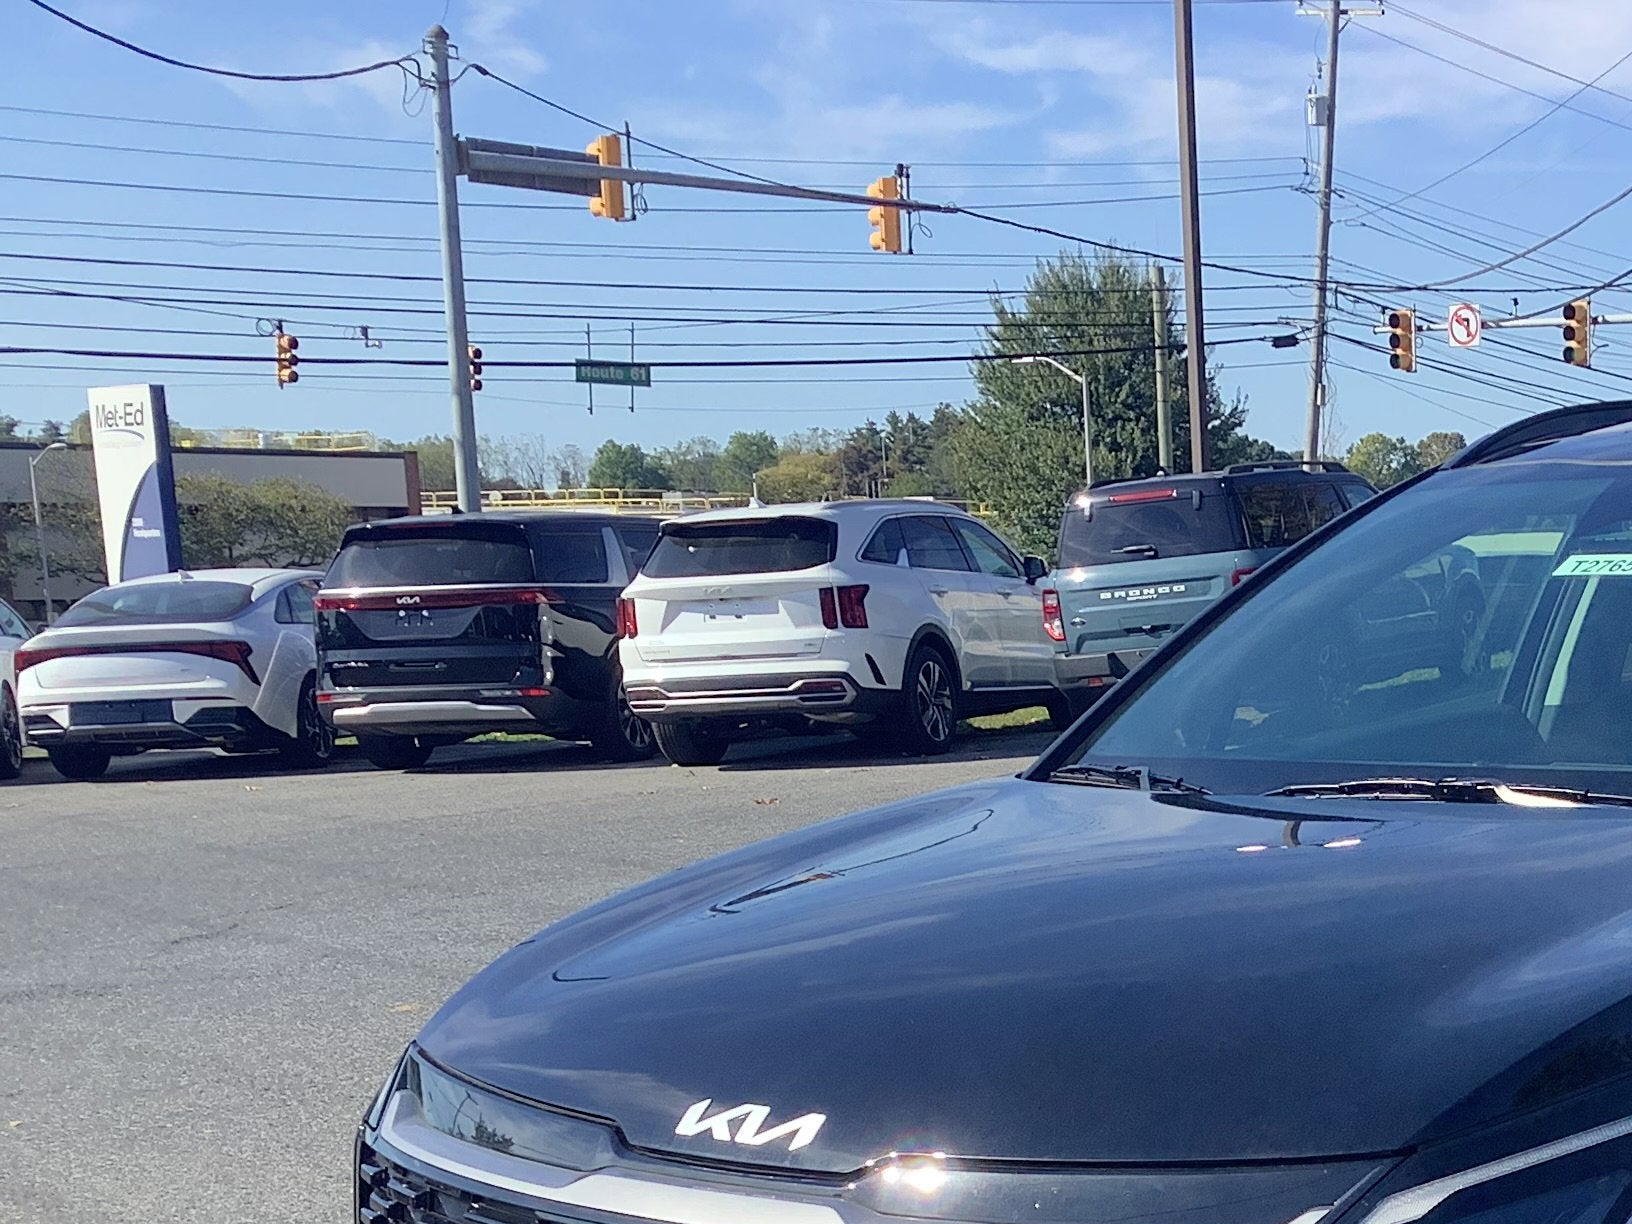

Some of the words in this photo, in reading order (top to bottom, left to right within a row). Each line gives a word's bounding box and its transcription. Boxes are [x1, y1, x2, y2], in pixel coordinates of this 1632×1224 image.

[581, 366, 624, 380] Route
[630, 367, 646, 381] 61
[96, 402, 145, 429] Met-Ed
[396, 596, 420, 604] KIA
[1100, 584, 1186, 600] BRONCO
[674, 1098, 827, 1152] KIA
